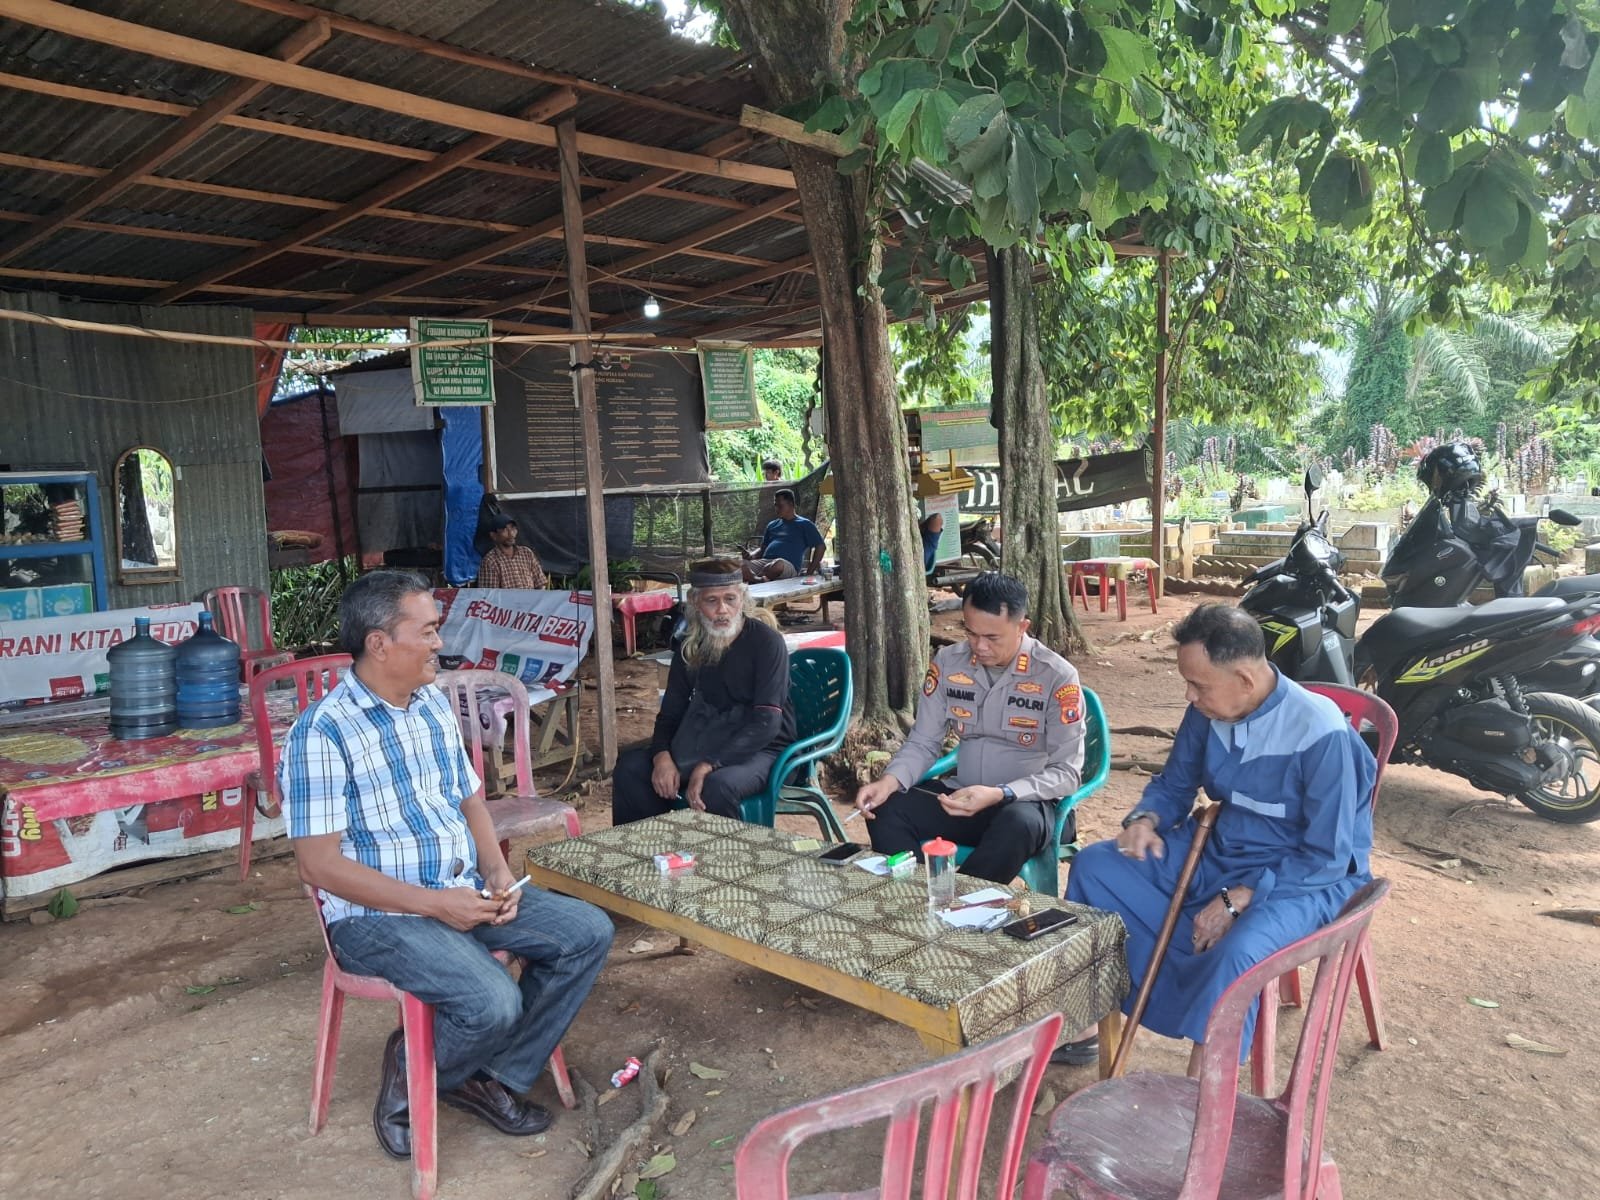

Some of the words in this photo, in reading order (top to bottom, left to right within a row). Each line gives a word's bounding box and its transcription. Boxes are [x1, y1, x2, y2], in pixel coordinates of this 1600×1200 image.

[69, 628, 124, 651] KITA
[131, 620, 199, 645] EDA
[511, 610, 544, 633] KITA
[540, 615, 586, 644] BEDA
[1007, 696, 1044, 711] POLRI
